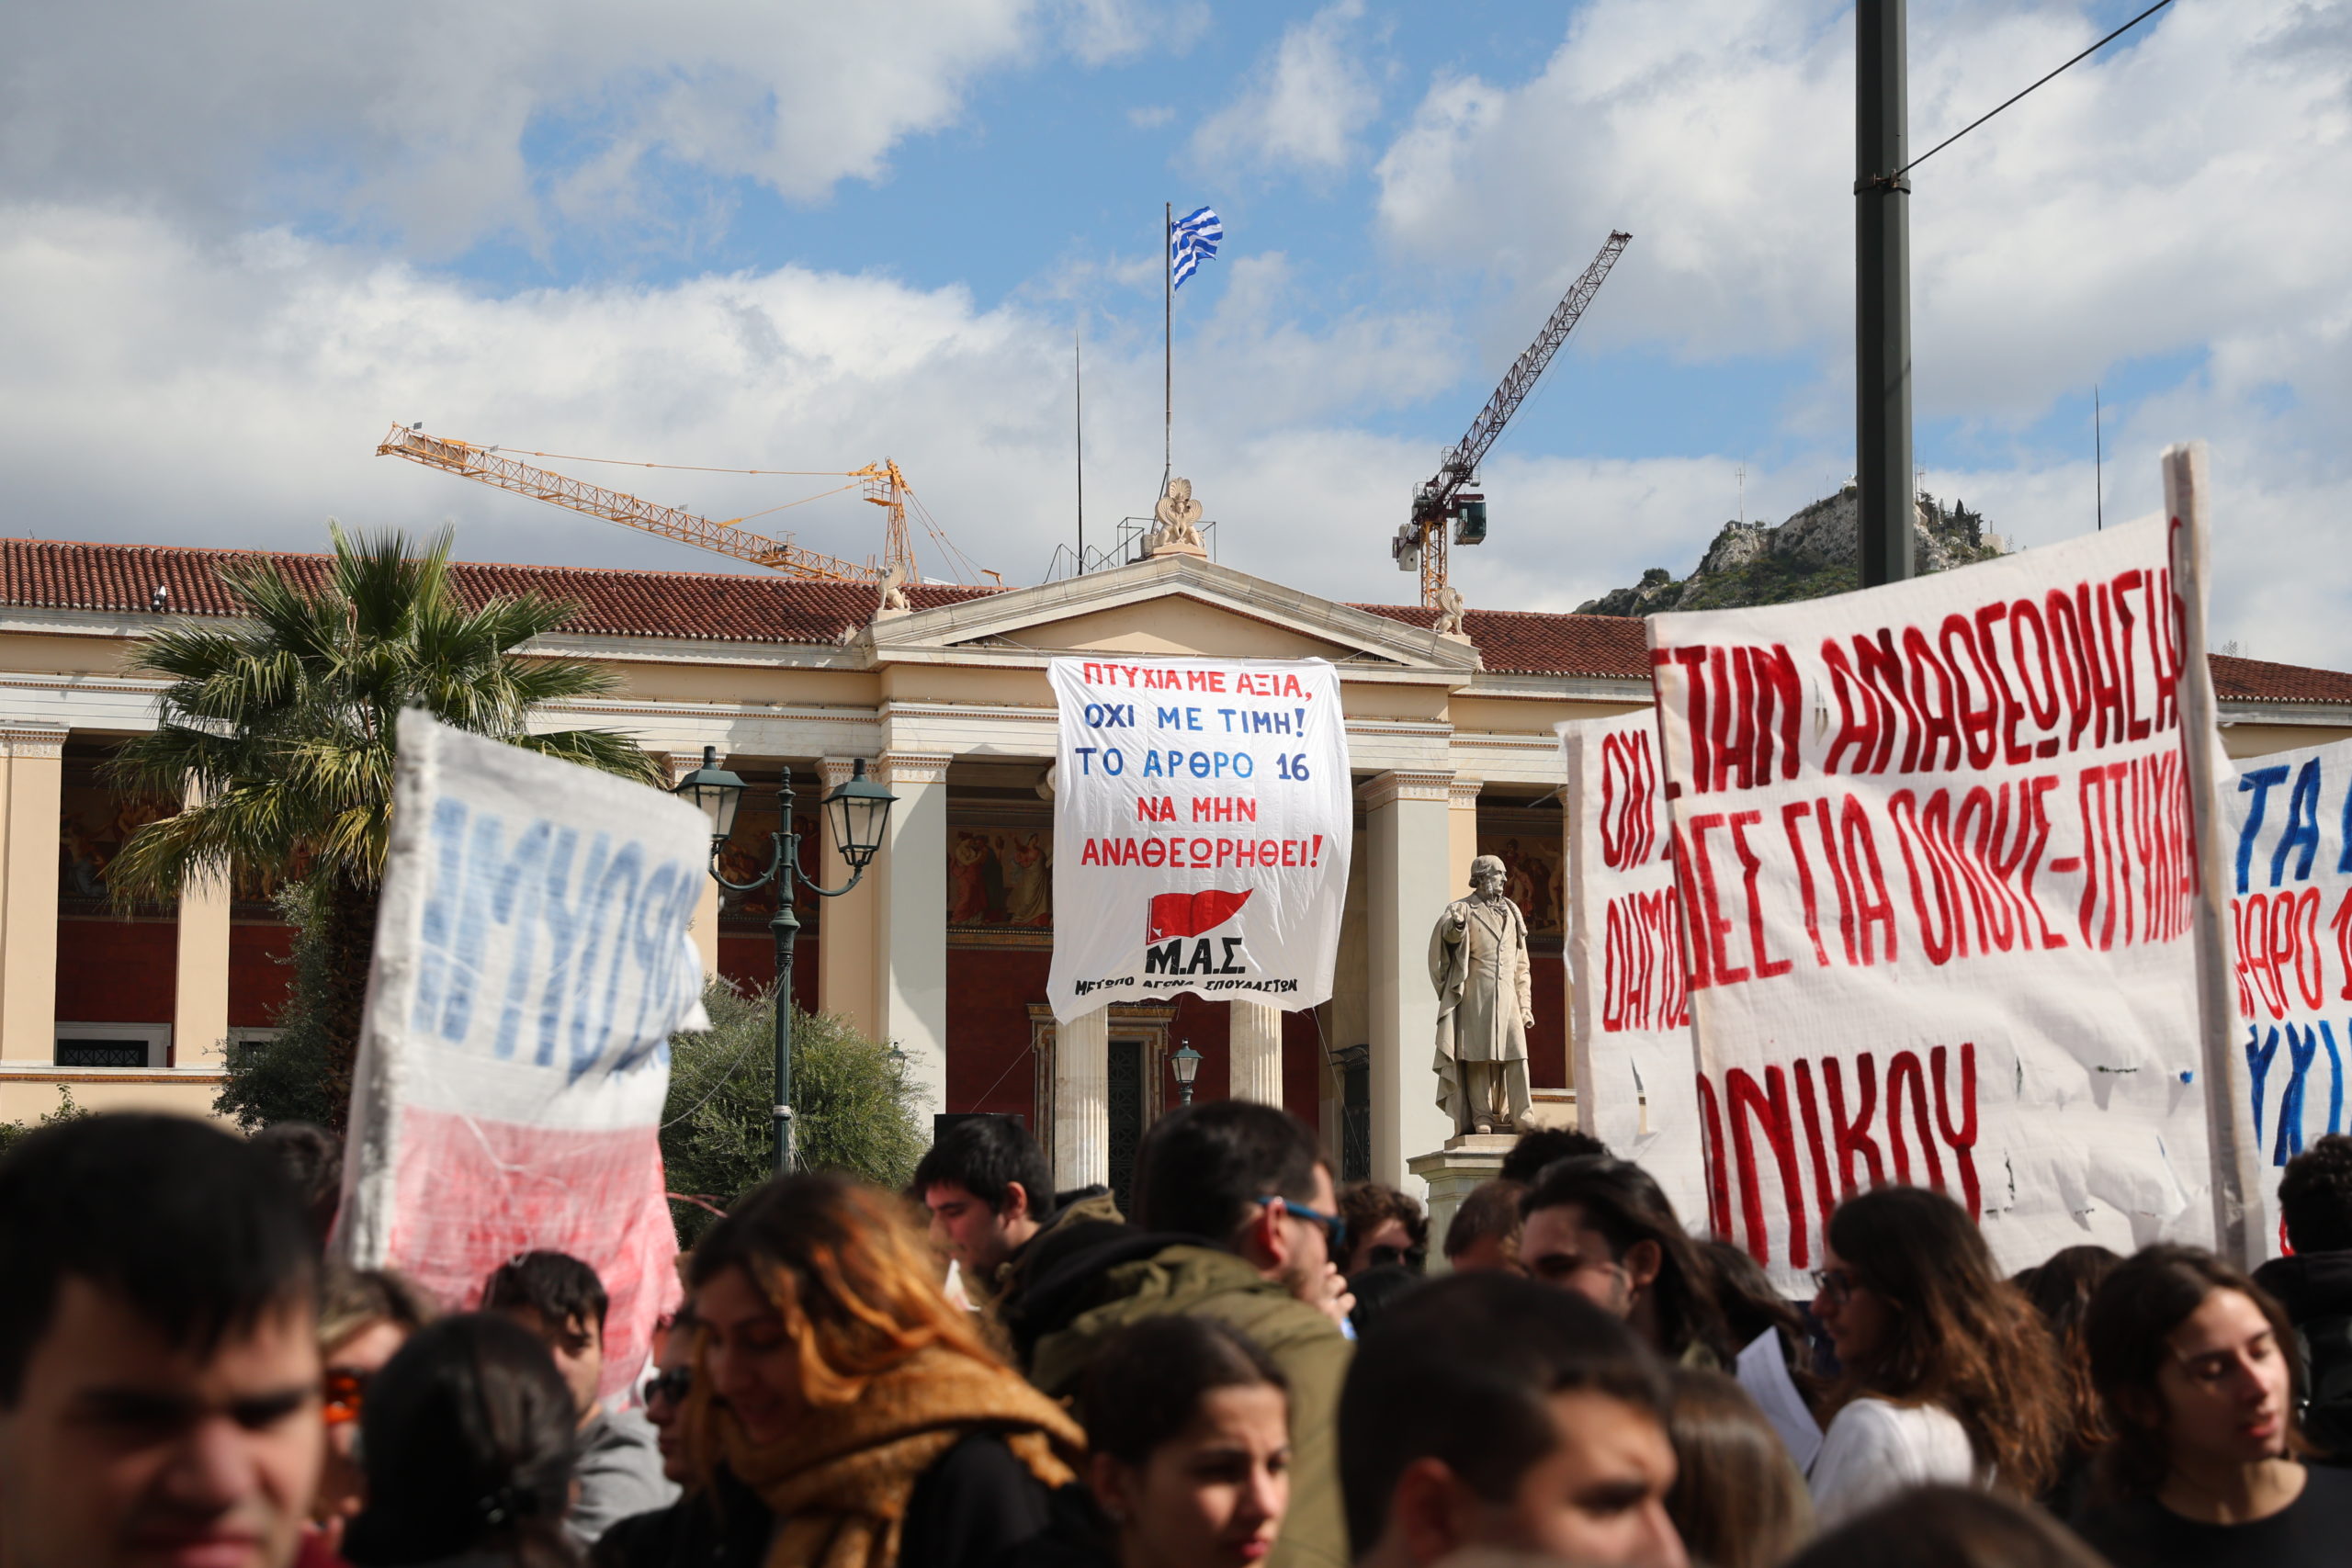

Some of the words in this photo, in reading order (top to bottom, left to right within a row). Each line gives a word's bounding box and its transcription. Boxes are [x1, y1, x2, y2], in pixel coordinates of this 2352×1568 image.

[1083, 662, 1182, 690] ΠΤΥΧΙΑ
[1186, 670, 1227, 694] ΜΕ
[1236, 673, 1312, 700] ΑΞΙΑ,
[1084, 703, 1135, 728] ΟΧΙ
[1158, 706, 1204, 731] ΜΕ
[1217, 708, 1305, 738] ΤΙΜΗ!
[1075, 748, 1124, 776] ΤΟ
[1143, 750, 1253, 779] ΑΡΘΡΟ
[1275, 753, 1309, 781] 16
[1137, 795, 1177, 822] ΝΑ
[1192, 796, 1256, 823] ΜΗΝ
[1600, 729, 1655, 872] ΟΧΙ
[1080, 834, 1324, 869] ΑΝΑΘΕΩΡΗΘΕΙ!
[1781, 793, 1898, 967] ΓΙΑ
[1145, 935, 1246, 976] Μ.Α.Σ.
[1601, 885, 1690, 1033] ΔΗΜΟ
[1075, 976, 1135, 996] ΜΕΤΩΠΟ
